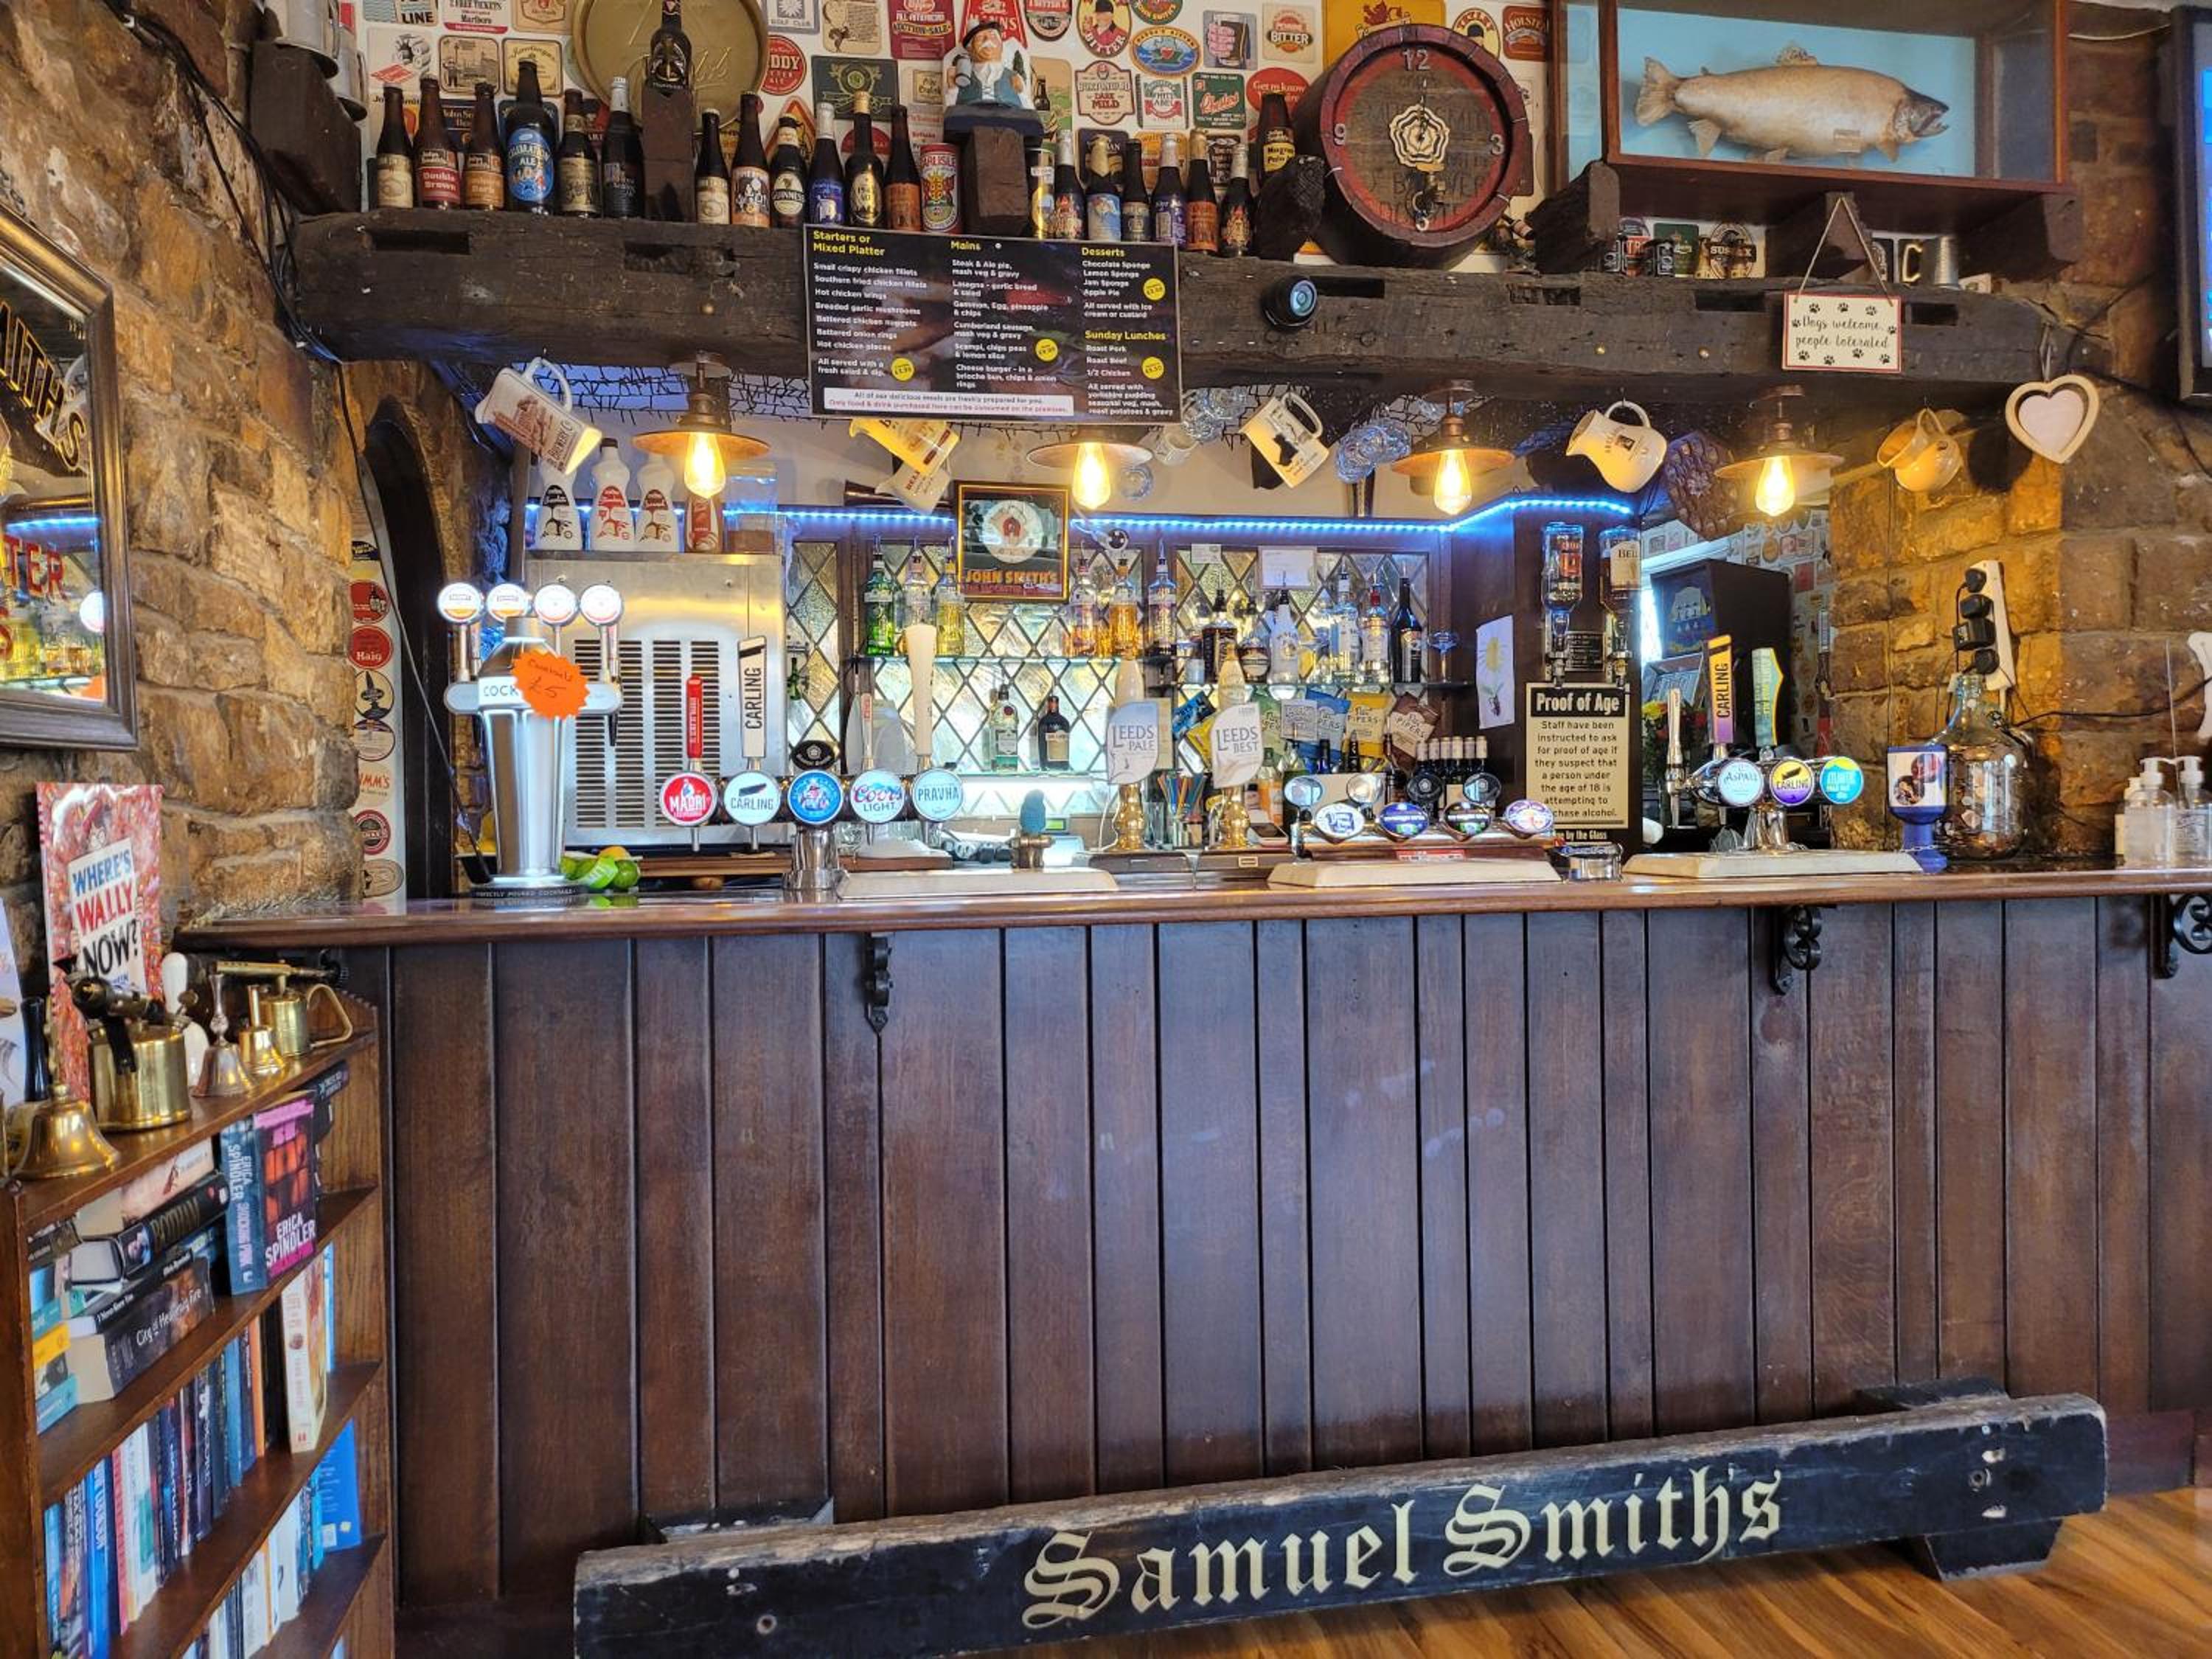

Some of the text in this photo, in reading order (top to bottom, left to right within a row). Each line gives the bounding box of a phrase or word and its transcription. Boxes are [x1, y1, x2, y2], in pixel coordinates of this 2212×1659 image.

[402, 12, 434, 24] LINE
[461, 14, 492, 24] Marlboro
[1085, 32, 1126, 55] BITTER
[1270, 32, 1310, 45] BITTER
[768, 55, 801, 70] DDY
[1402, 49, 1431, 72] 12
[1092, 100, 1120, 108] MILD
[1333, 122, 1346, 146] 9
[1489, 133, 1506, 156] 3
[519, 157, 536, 166] ALE
[422, 171, 456, 181] Double
[424, 181, 457, 191] Brown
[774, 191, 805, 201] GUINNESS
[813, 230, 870, 243] Starters or
[813, 243, 885, 256] Mixed Platter
[950, 241, 981, 250] Mains
[1082, 247, 1124, 257] Desserts
[1709, 245, 1753, 258] SUSX
[813, 262, 835, 271] Small
[863, 266, 894, 274] chicken
[1110, 270, 1139, 278] Sponge
[815, 275, 851, 284] Southern
[852, 277, 871, 285] fried
[873, 279, 902, 287] chicken
[832, 289, 861, 297] chicken
[815, 302, 920, 315] Breaded garlic mushrooms
[1803, 316, 1827, 332] Dogs
[1085, 330, 1166, 341] Sunday Lunches
[1795, 335, 1829, 349] people
[966, 570, 1003, 583] JOHN
[355, 651, 383, 662] Haig
[483, 685, 518, 697] COCK
[1715, 662, 1731, 719] CARLING
[744, 667, 763, 729] CARLING
[1536, 692, 1619, 715] Proof of Age
[1541, 720, 1614, 729] Staff have been
[1113, 724, 1155, 748] LEEDS
[1216, 726, 1259, 751] LEEDS
[1537, 734, 1586, 742] instructed
[1601, 734, 1617, 742] ask
[1128, 739, 1155, 751] PALE
[1233, 741, 1260, 754] BEST
[1537, 746, 1618, 756] for proof of age if
[1535, 759, 1617, 768] they suspect that
[1550, 772, 1582, 781] person
[1585, 771, 1610, 779] under
[1541, 783, 1556, 791] the
[1559, 785, 1575, 793] age
[1578, 783, 1587, 791] of
[1775, 779, 1809, 790] CARLING
[852, 784, 902, 803] Coors
[918, 785, 960, 801] PRAVHA
[731, 797, 774, 810] CARLING
[863, 801, 896, 812] LIGHT
[1544, 796, 1595, 805] attempting
[1554, 809, 1579, 817] chase
[72, 849, 131, 897] WHERE'S
[75, 882, 133, 932] WALLY
[82, 918, 139, 978] NOW?
[228, 1144, 245, 1203] SPINDLER
[242, 1155, 254, 1186] ERICA
[276, 1211, 305, 1240] ERICA
[265, 1219, 316, 1268] SPINDLER
[136, 1327, 153, 1346] City
[188, 1288, 202, 1304] Fire
[1023, 1500, 1416, 1630] Samuel
